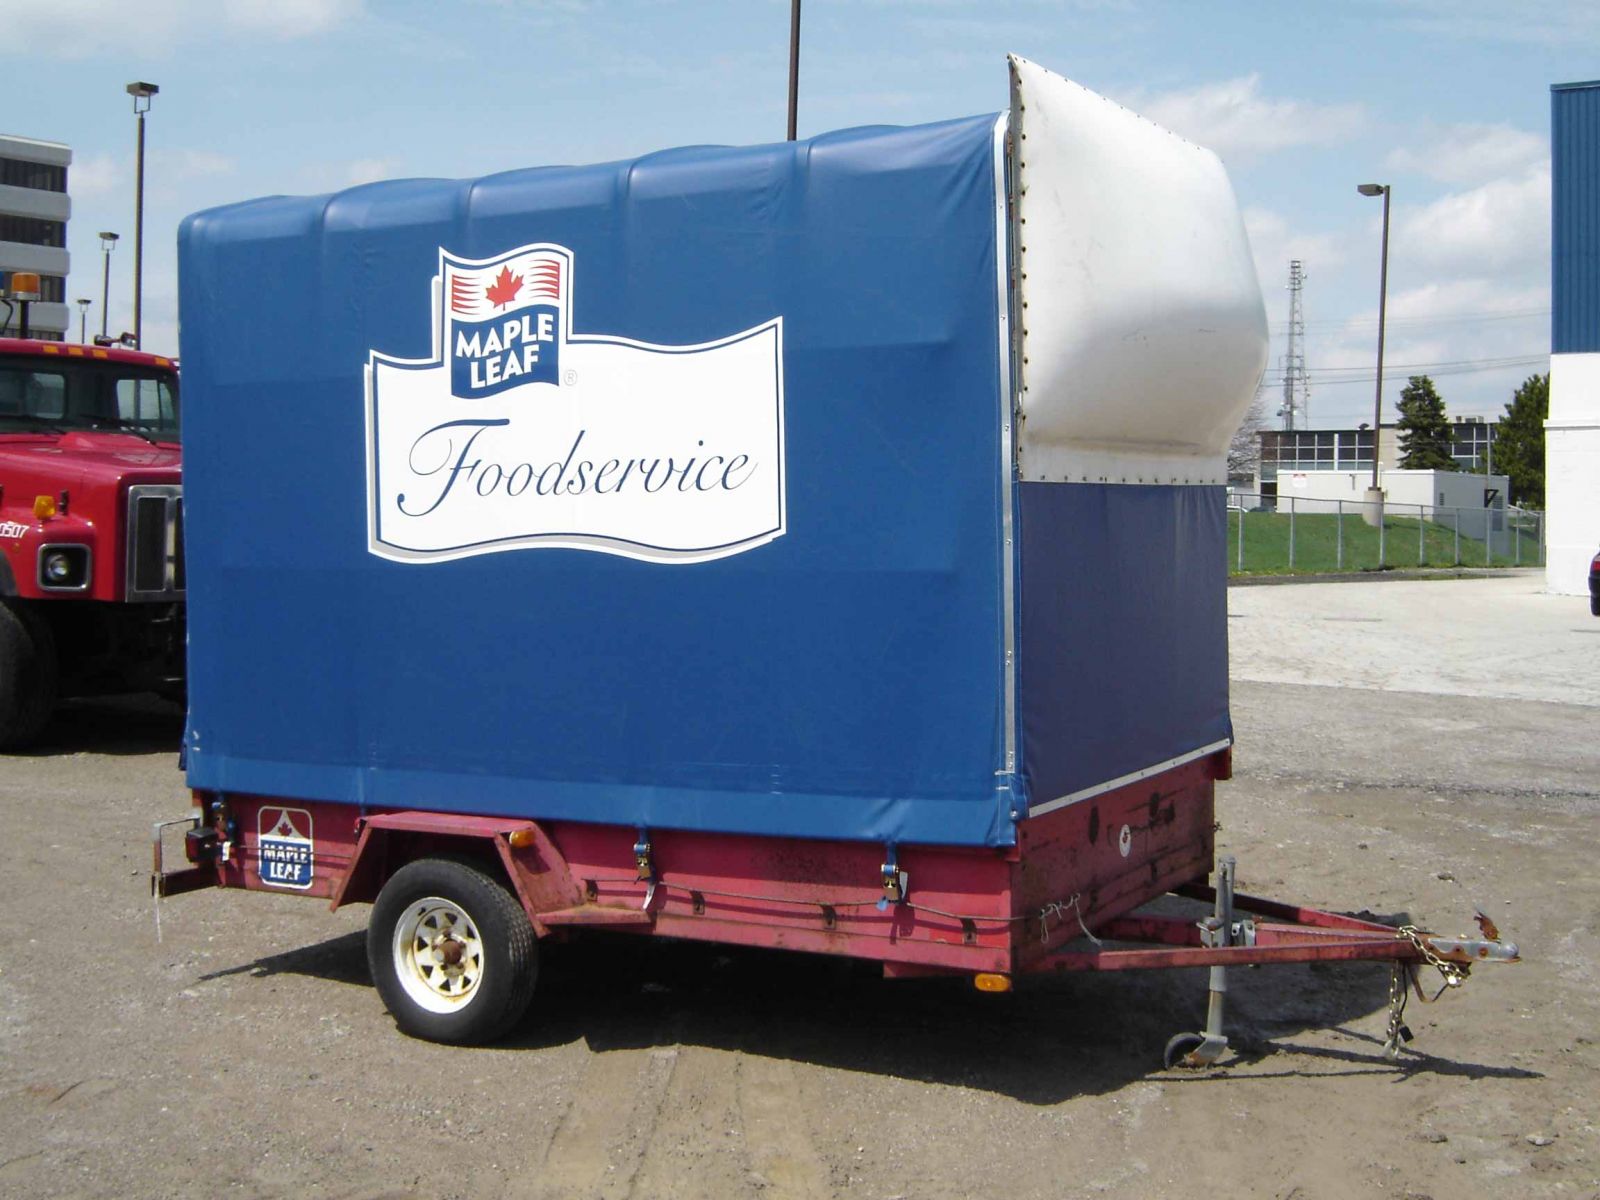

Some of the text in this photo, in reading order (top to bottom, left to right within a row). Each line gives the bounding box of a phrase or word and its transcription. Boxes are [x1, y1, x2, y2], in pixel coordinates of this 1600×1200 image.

[455, 313, 554, 358] MAPLE
[470, 345, 540, 389] LEAF
[397, 418, 758, 517] Foodservice
[263, 844, 308, 863] MAPLE
[270, 861, 302, 881] LEAF
